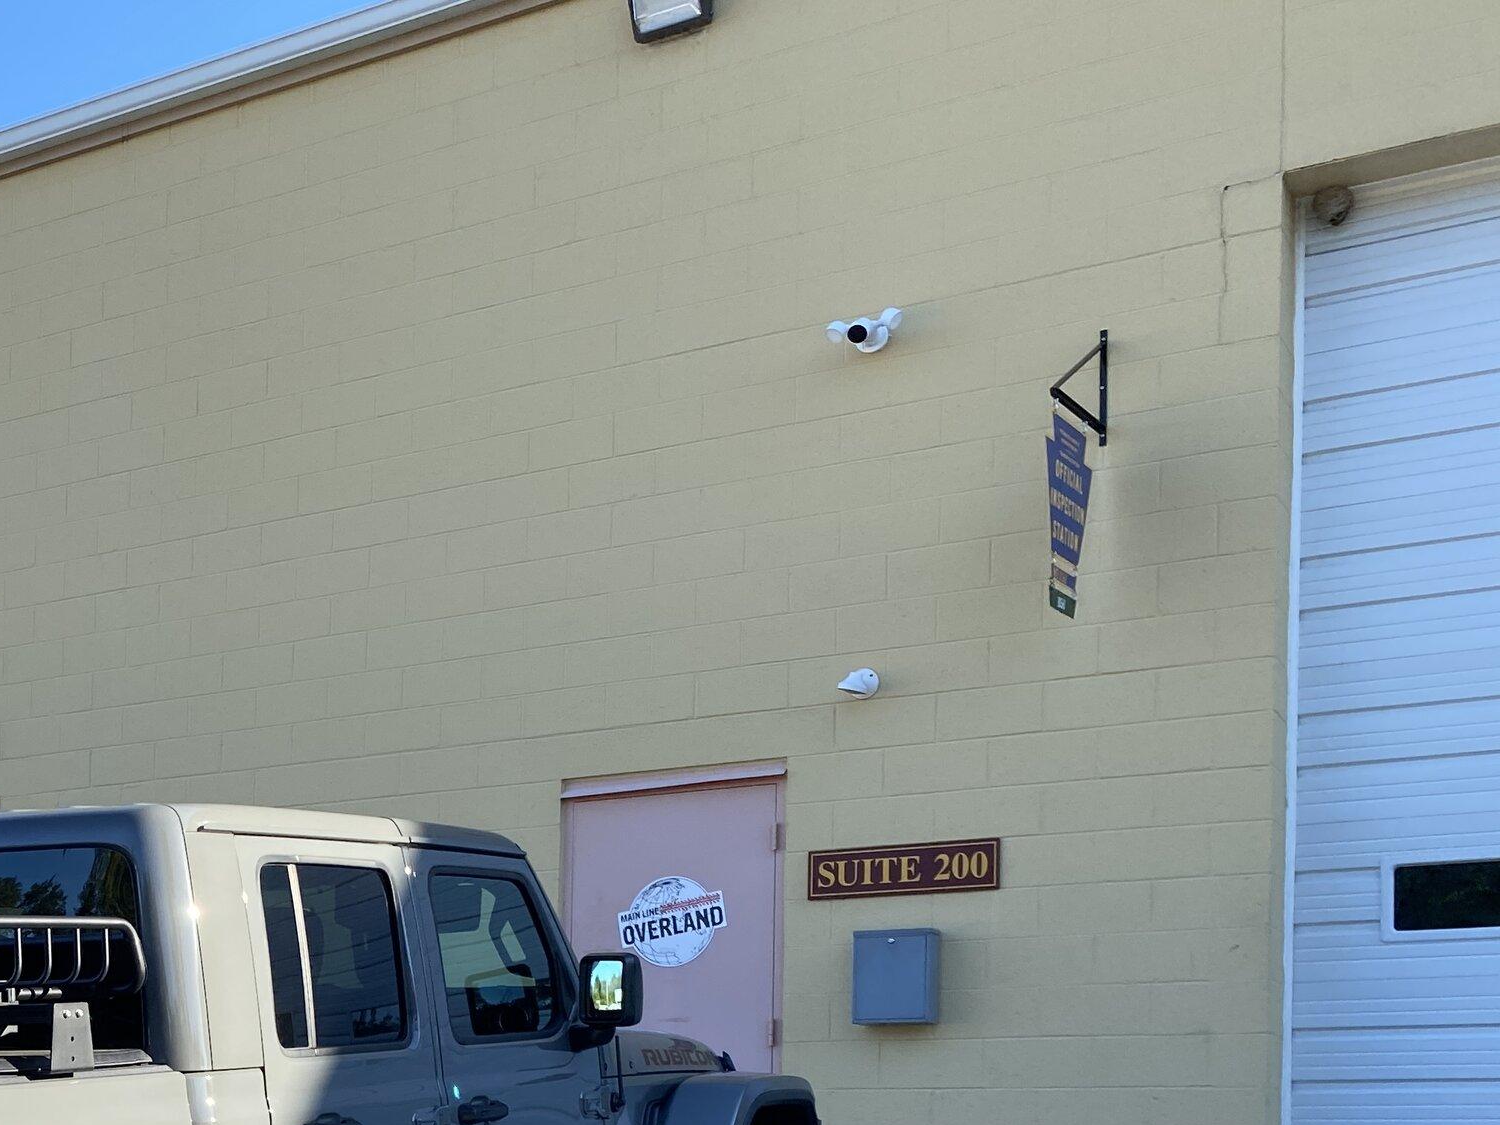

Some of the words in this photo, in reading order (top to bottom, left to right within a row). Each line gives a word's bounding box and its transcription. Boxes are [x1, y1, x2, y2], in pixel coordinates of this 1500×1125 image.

[1055, 459, 1083, 495] OFFICIAL
[1050, 486, 1085, 527] INSPECTION
[1052, 520, 1079, 553] STATION
[817, 855, 921, 888] SUITE
[933, 851, 989, 881] 200
[620, 912, 641, 922] MAIN
[642, 907, 660, 918] LINE
[622, 905, 724, 946] OVERLAND
